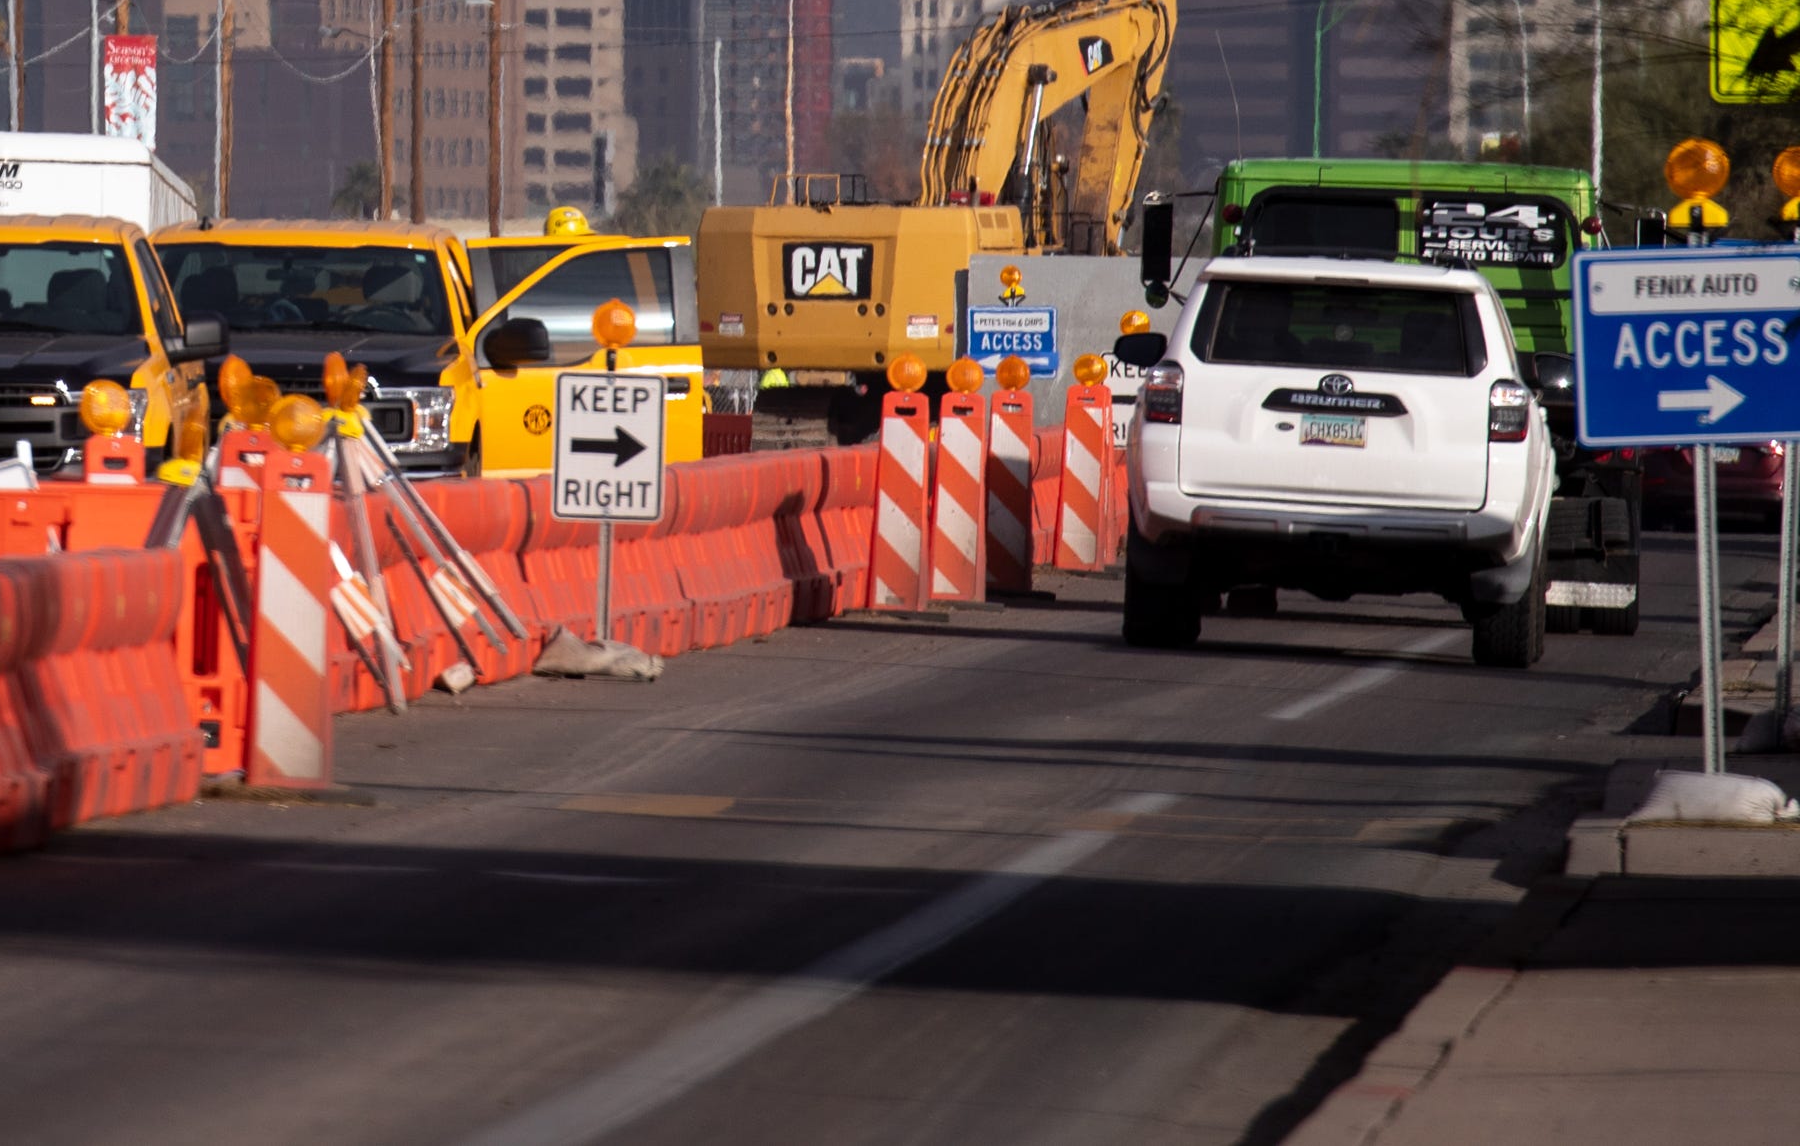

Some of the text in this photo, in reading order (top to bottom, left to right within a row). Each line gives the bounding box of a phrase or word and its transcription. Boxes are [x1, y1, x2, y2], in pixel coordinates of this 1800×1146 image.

[107, 38, 156, 56] Season's
[1432, 202, 1547, 229] 24
[1422, 225, 1555, 243] HOURS
[1447, 239, 1529, 252] SERVICE
[1492, 251, 1554, 263] REPAIR
[790, 245, 865, 297] CAT
[1634, 272, 1758, 298] FENIX AUTO
[981, 333, 1043, 351] ACCESS
[1613, 317, 1789, 370] ACCESS
[570, 384, 651, 414] KEEP
[563, 478, 653, 509] RIGHT
